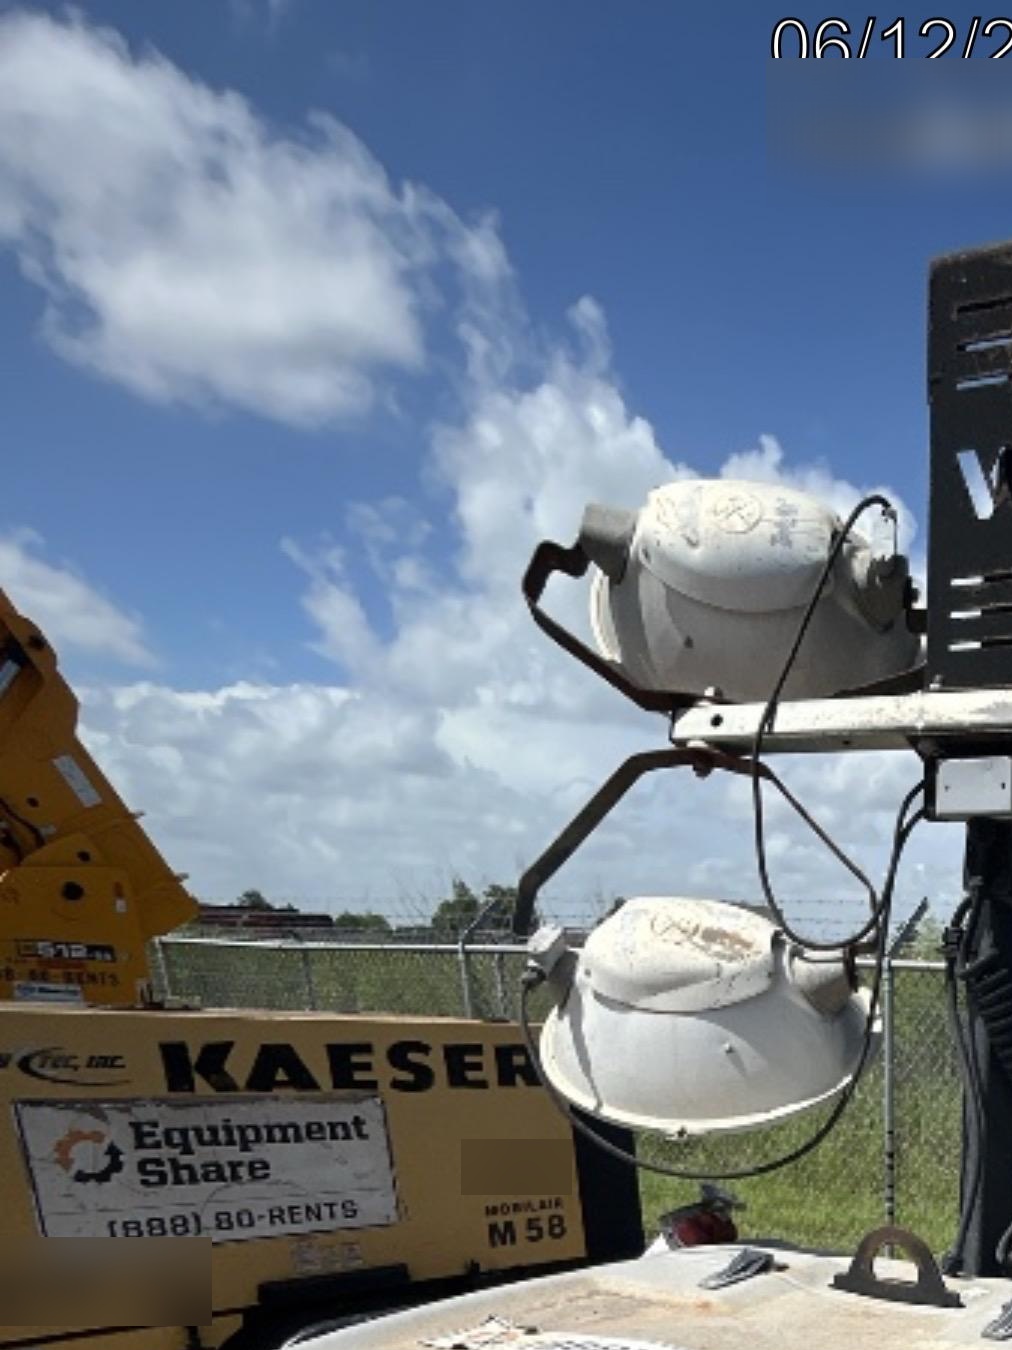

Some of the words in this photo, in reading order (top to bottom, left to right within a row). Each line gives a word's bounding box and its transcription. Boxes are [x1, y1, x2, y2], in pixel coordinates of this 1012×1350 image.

[158, 1041, 543, 1092] KAESER
[129, 1115, 369, 1155] Equipment
[138, 1157, 271, 1188] Share
[215, 1200, 359, 1231] 80-RENTS
[488, 1220, 516, 1248] M
[525, 1214, 567, 1243] 58
